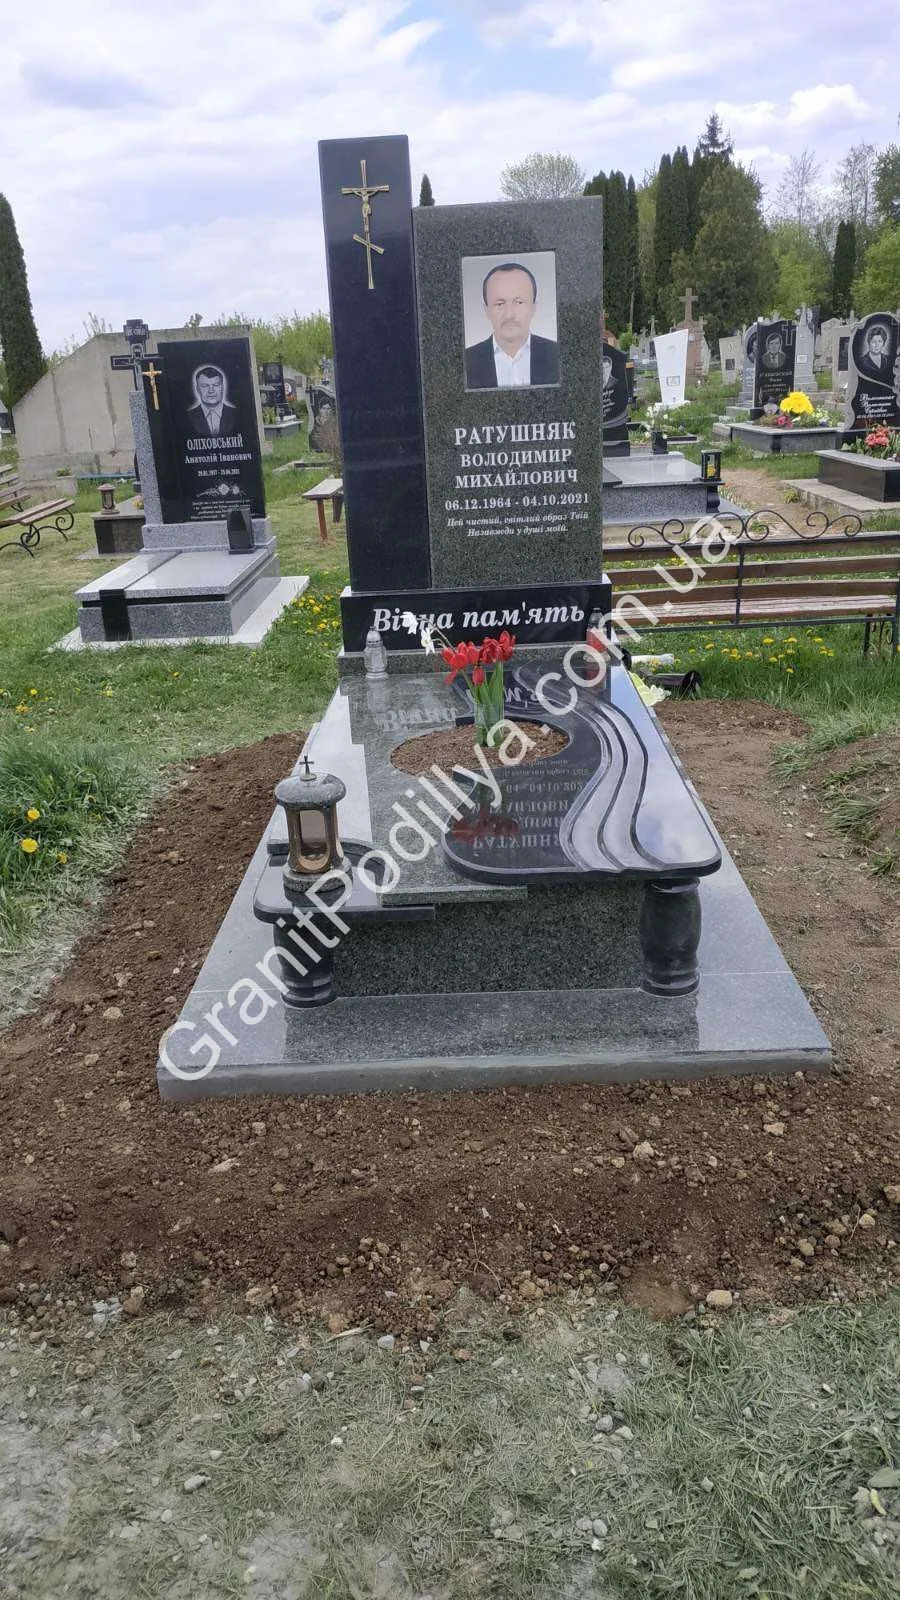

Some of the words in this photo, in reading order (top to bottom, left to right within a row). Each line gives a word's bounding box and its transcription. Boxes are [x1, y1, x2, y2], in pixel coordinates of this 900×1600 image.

[187, 433, 243, 450] ОЛІХОВСЬКИЙ
[454, 421, 576, 446] РАТУШНЯК
[185, 453, 218, 464] Анатолій
[219, 453, 252, 461] Іванович
[460, 449, 572, 468] ВОЛОДИМИР
[455, 469, 578, 489] МИХАЙЛОВИЧ
[445, 497, 511, 511] 06.12.1964
[522, 493, 589, 507] 04.10.2021
[373, 607, 453, 632] Віна
[462, 602, 585, 627] пам'ять
